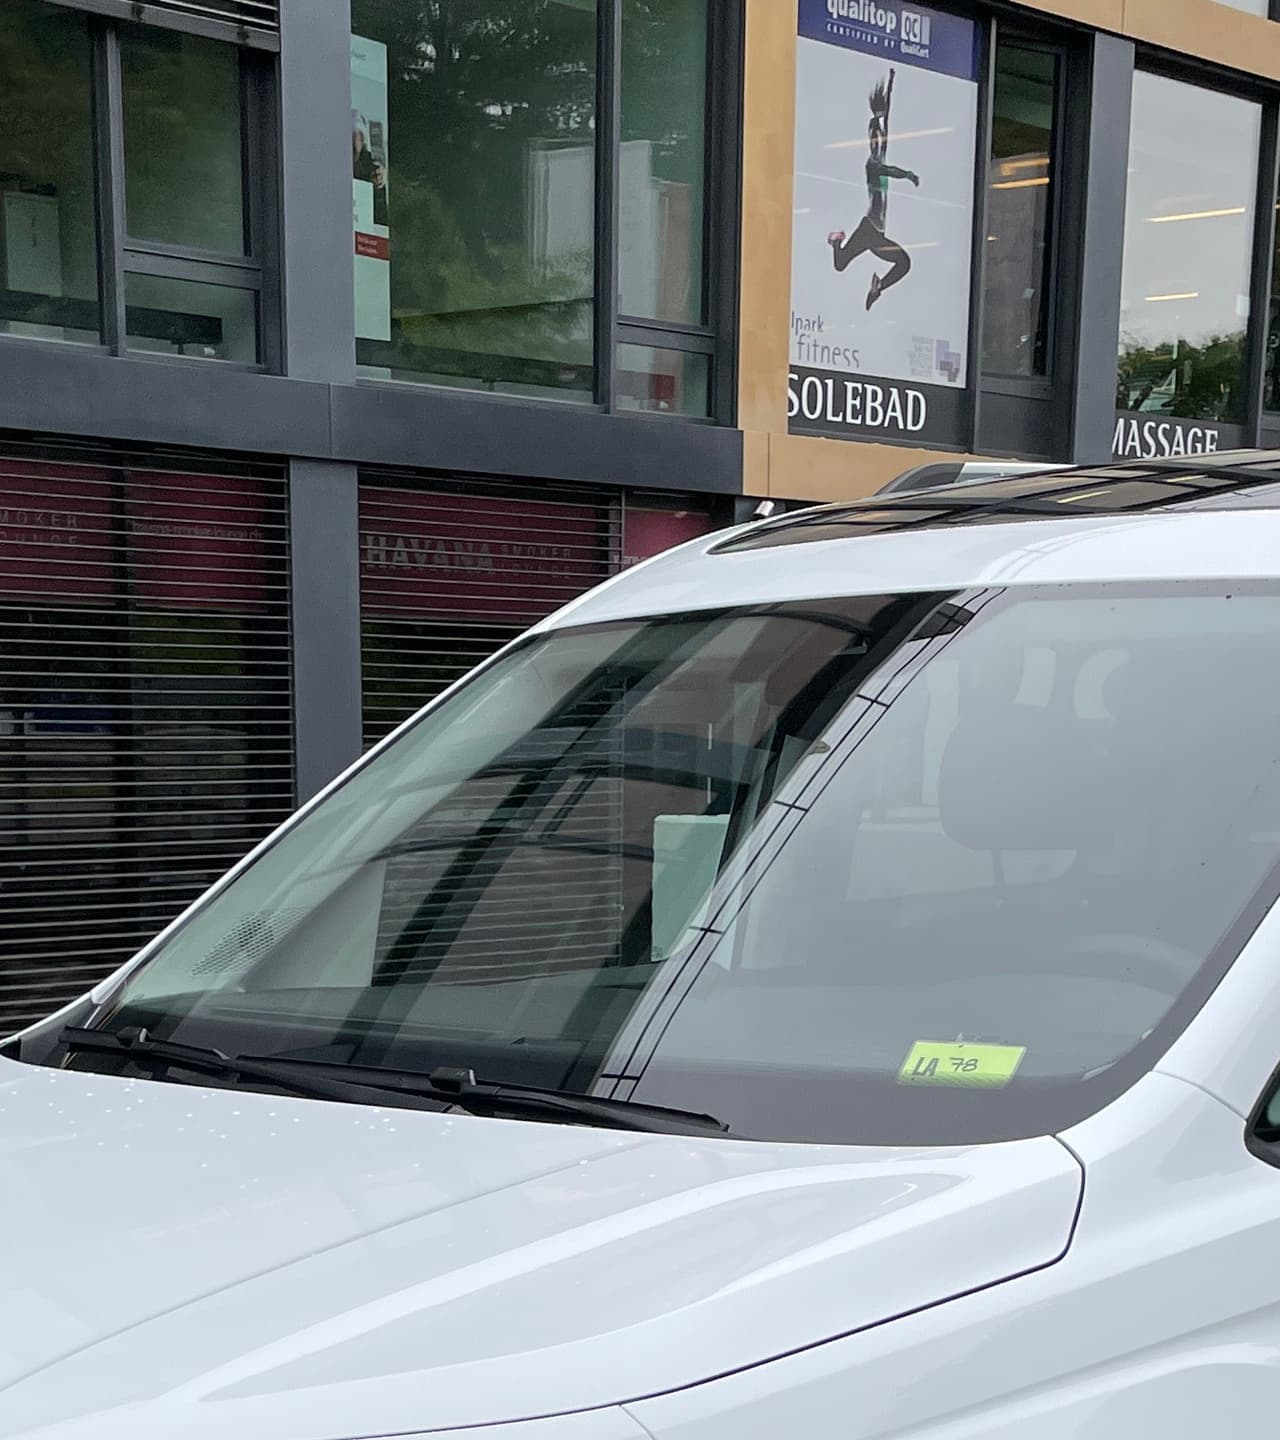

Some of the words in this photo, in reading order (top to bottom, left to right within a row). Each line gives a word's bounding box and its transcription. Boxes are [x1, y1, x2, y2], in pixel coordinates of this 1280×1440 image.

[827, 0, 897, 33] qualitop
[797, 333, 860, 369] fitness
[787, 373, 926, 432] SOLEBAD
[911, 1056, 940, 1077] LA
[948, 1056, 979, 1073] 78
